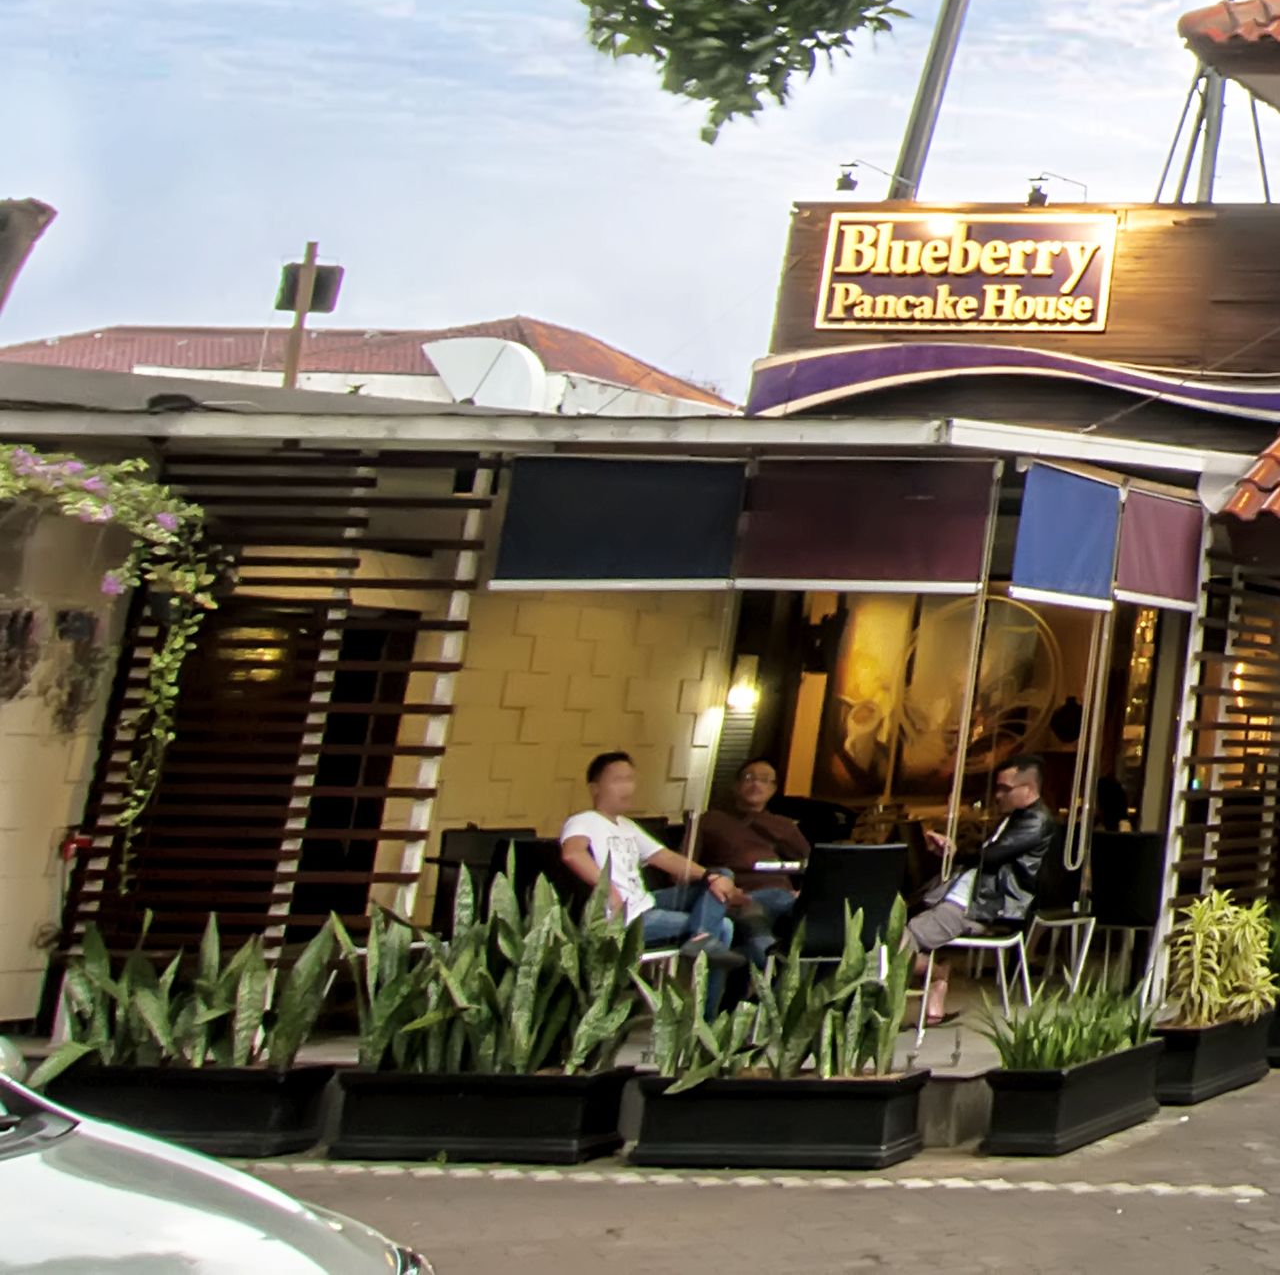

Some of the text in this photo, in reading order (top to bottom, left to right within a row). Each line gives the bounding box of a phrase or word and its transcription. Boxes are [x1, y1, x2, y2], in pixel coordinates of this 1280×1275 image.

[833, 221, 1102, 294] Blueberry
[827, 282, 1094, 322] Pancake House
